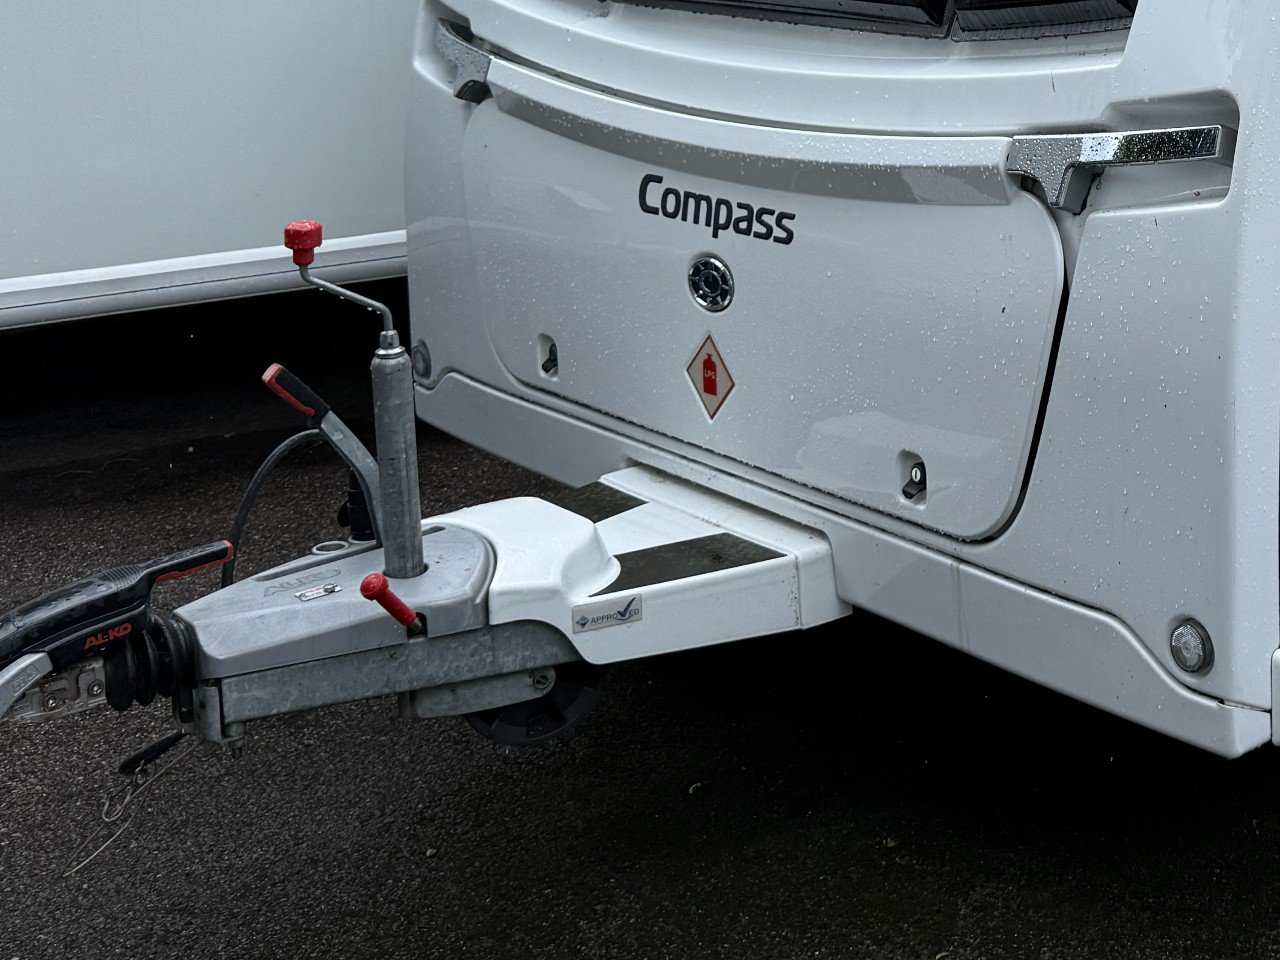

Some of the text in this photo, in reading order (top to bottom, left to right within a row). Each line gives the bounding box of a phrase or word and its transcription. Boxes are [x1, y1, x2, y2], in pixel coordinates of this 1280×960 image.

[639, 173, 796, 245] Compass
[704, 370, 716, 379] LPG
[84, 623, 132, 651] AL-KO
